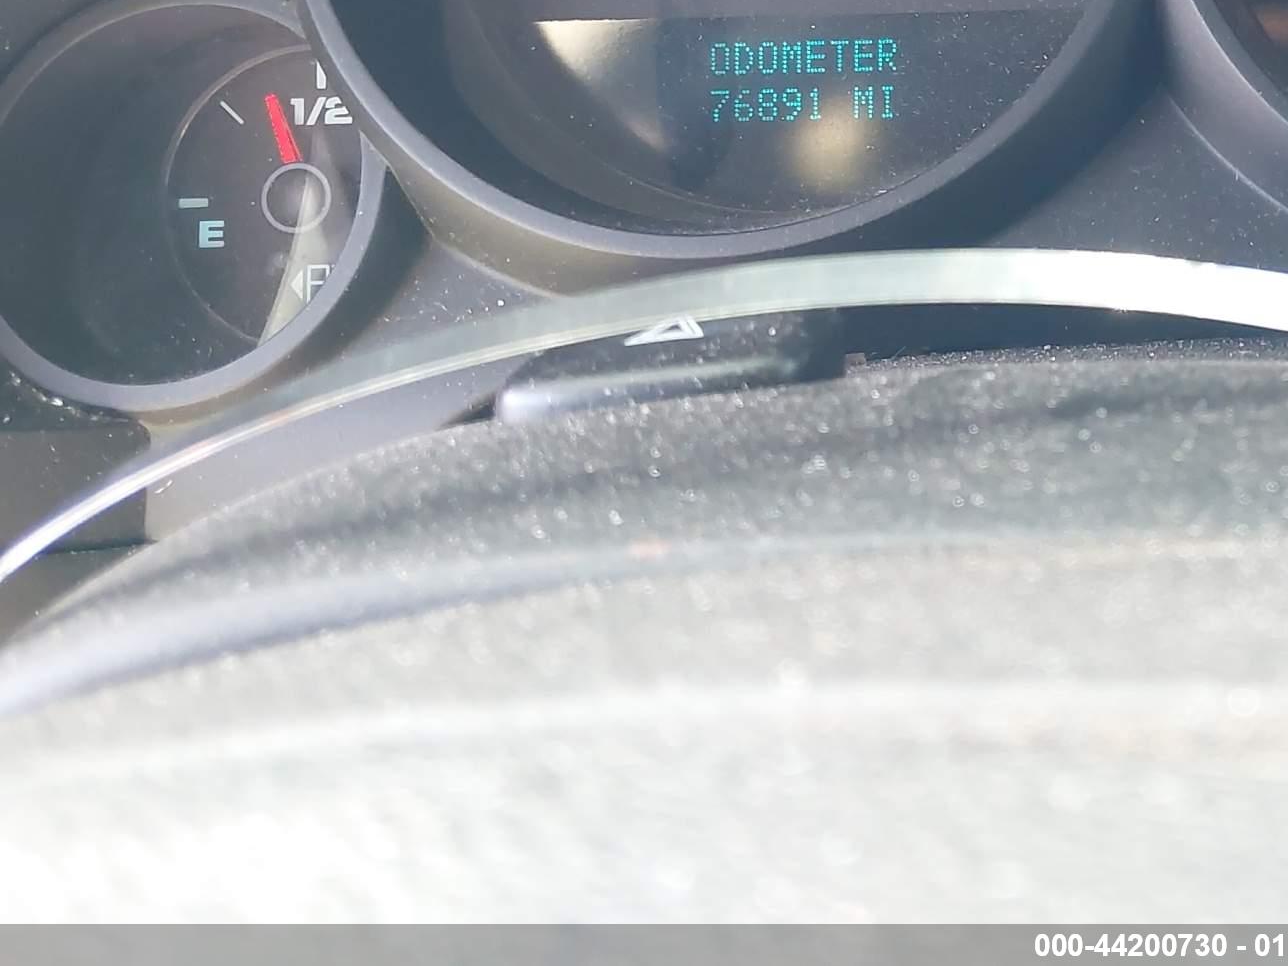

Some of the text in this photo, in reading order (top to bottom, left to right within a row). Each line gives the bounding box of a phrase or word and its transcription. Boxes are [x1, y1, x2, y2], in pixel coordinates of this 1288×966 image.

[710, 39, 897, 75] ODOMETER
[290, 96, 353, 126] 1/2
[710, 85, 894, 122] 76891 MI
[199, 220, 225, 248] E
